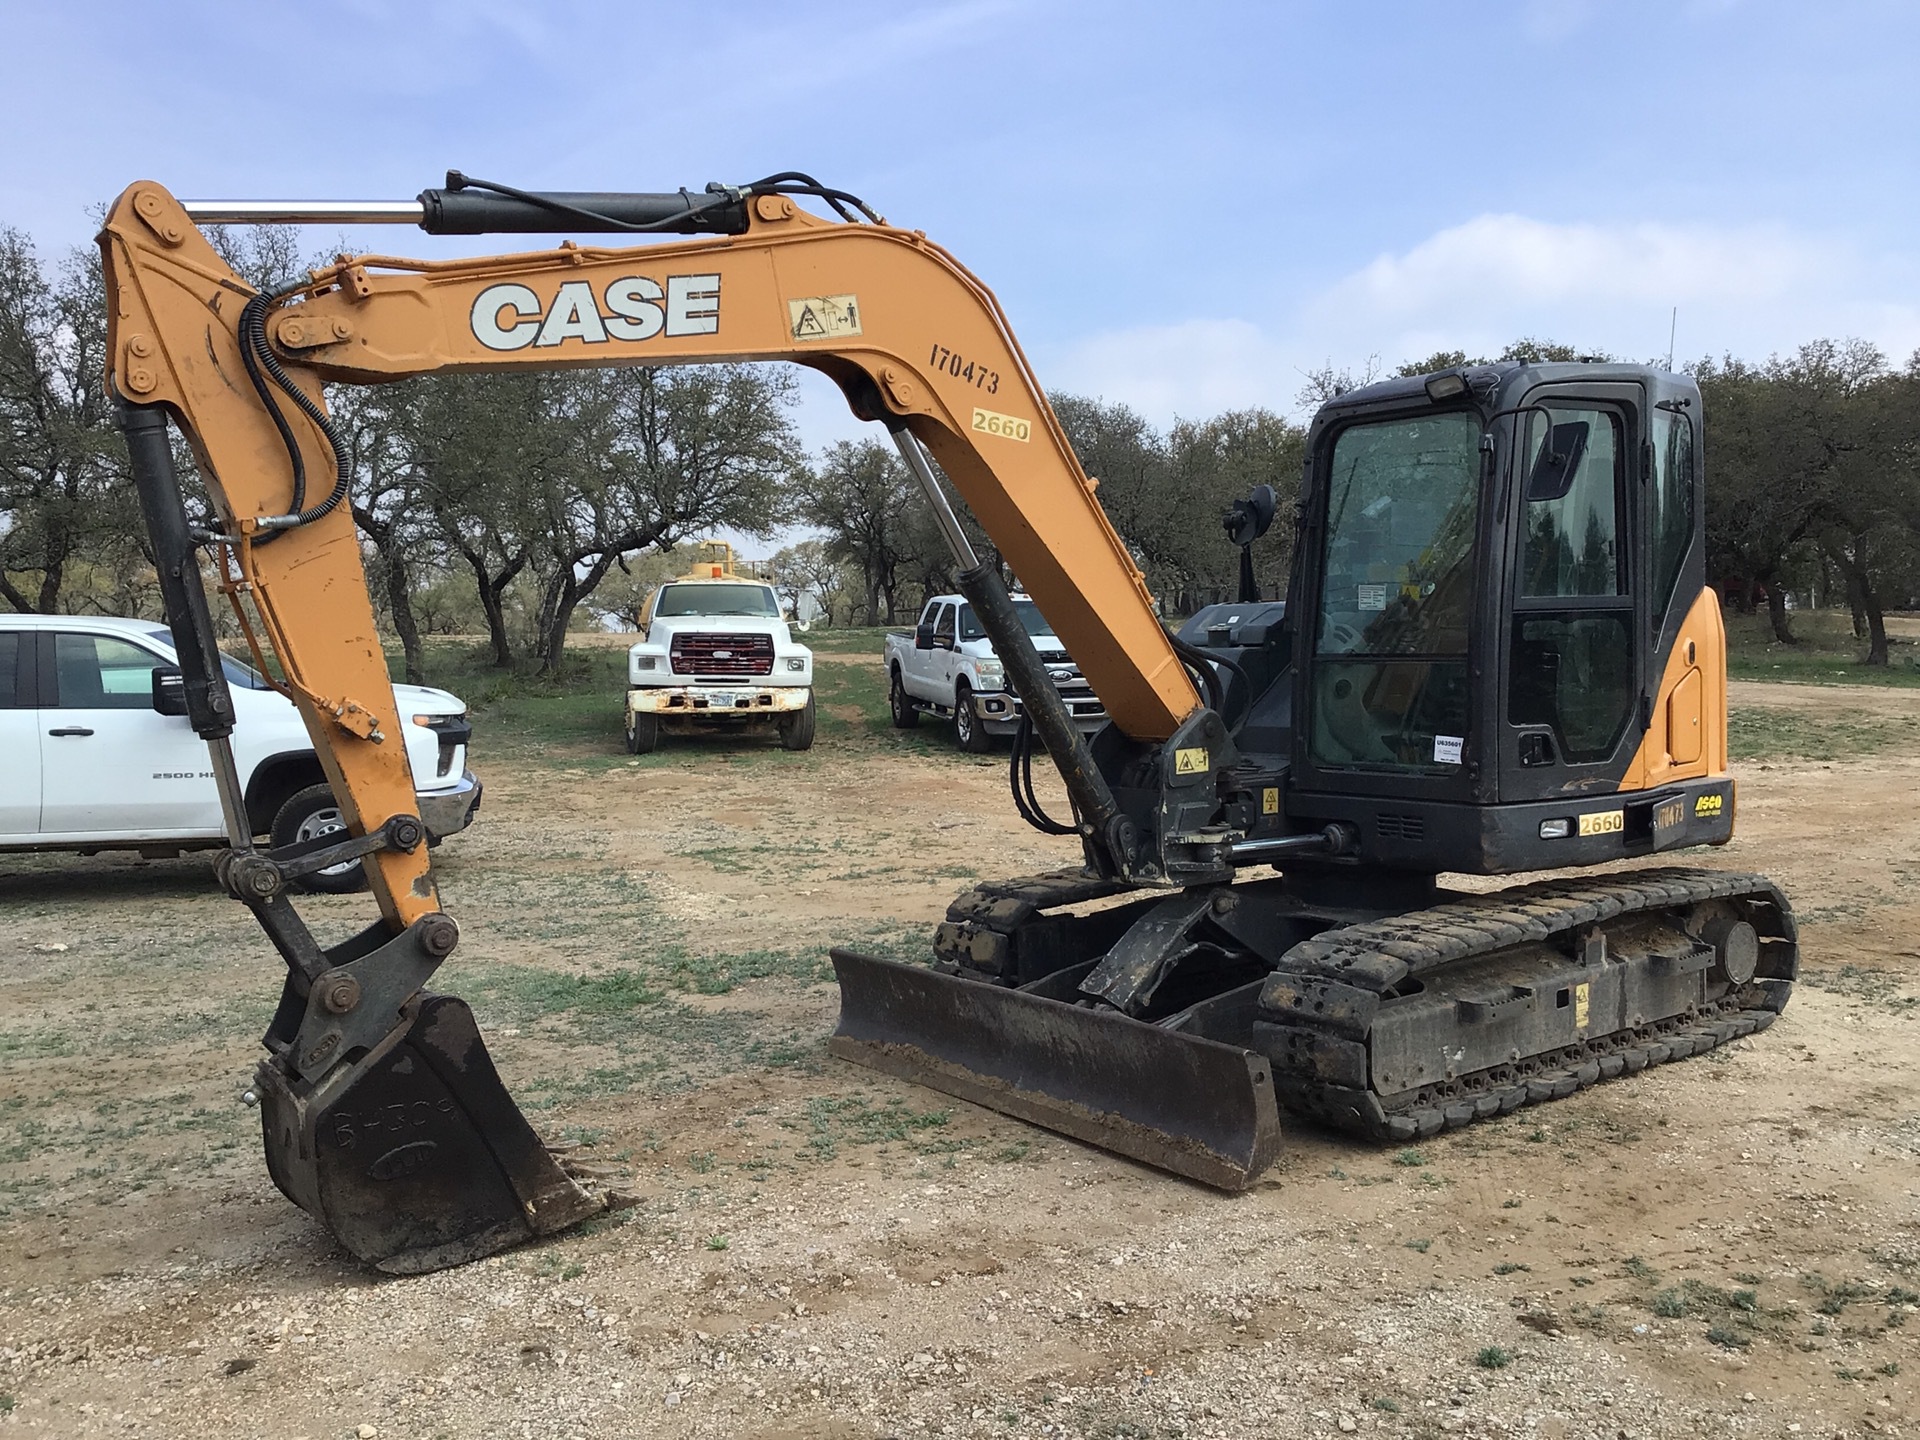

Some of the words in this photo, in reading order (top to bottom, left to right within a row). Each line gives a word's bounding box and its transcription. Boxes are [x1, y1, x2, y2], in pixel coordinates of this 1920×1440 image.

[470, 273, 721, 352] CASE
[930, 343, 999, 394] 170473
[973, 412, 1028, 440] 2660
[1581, 814, 1622, 833] 2660
